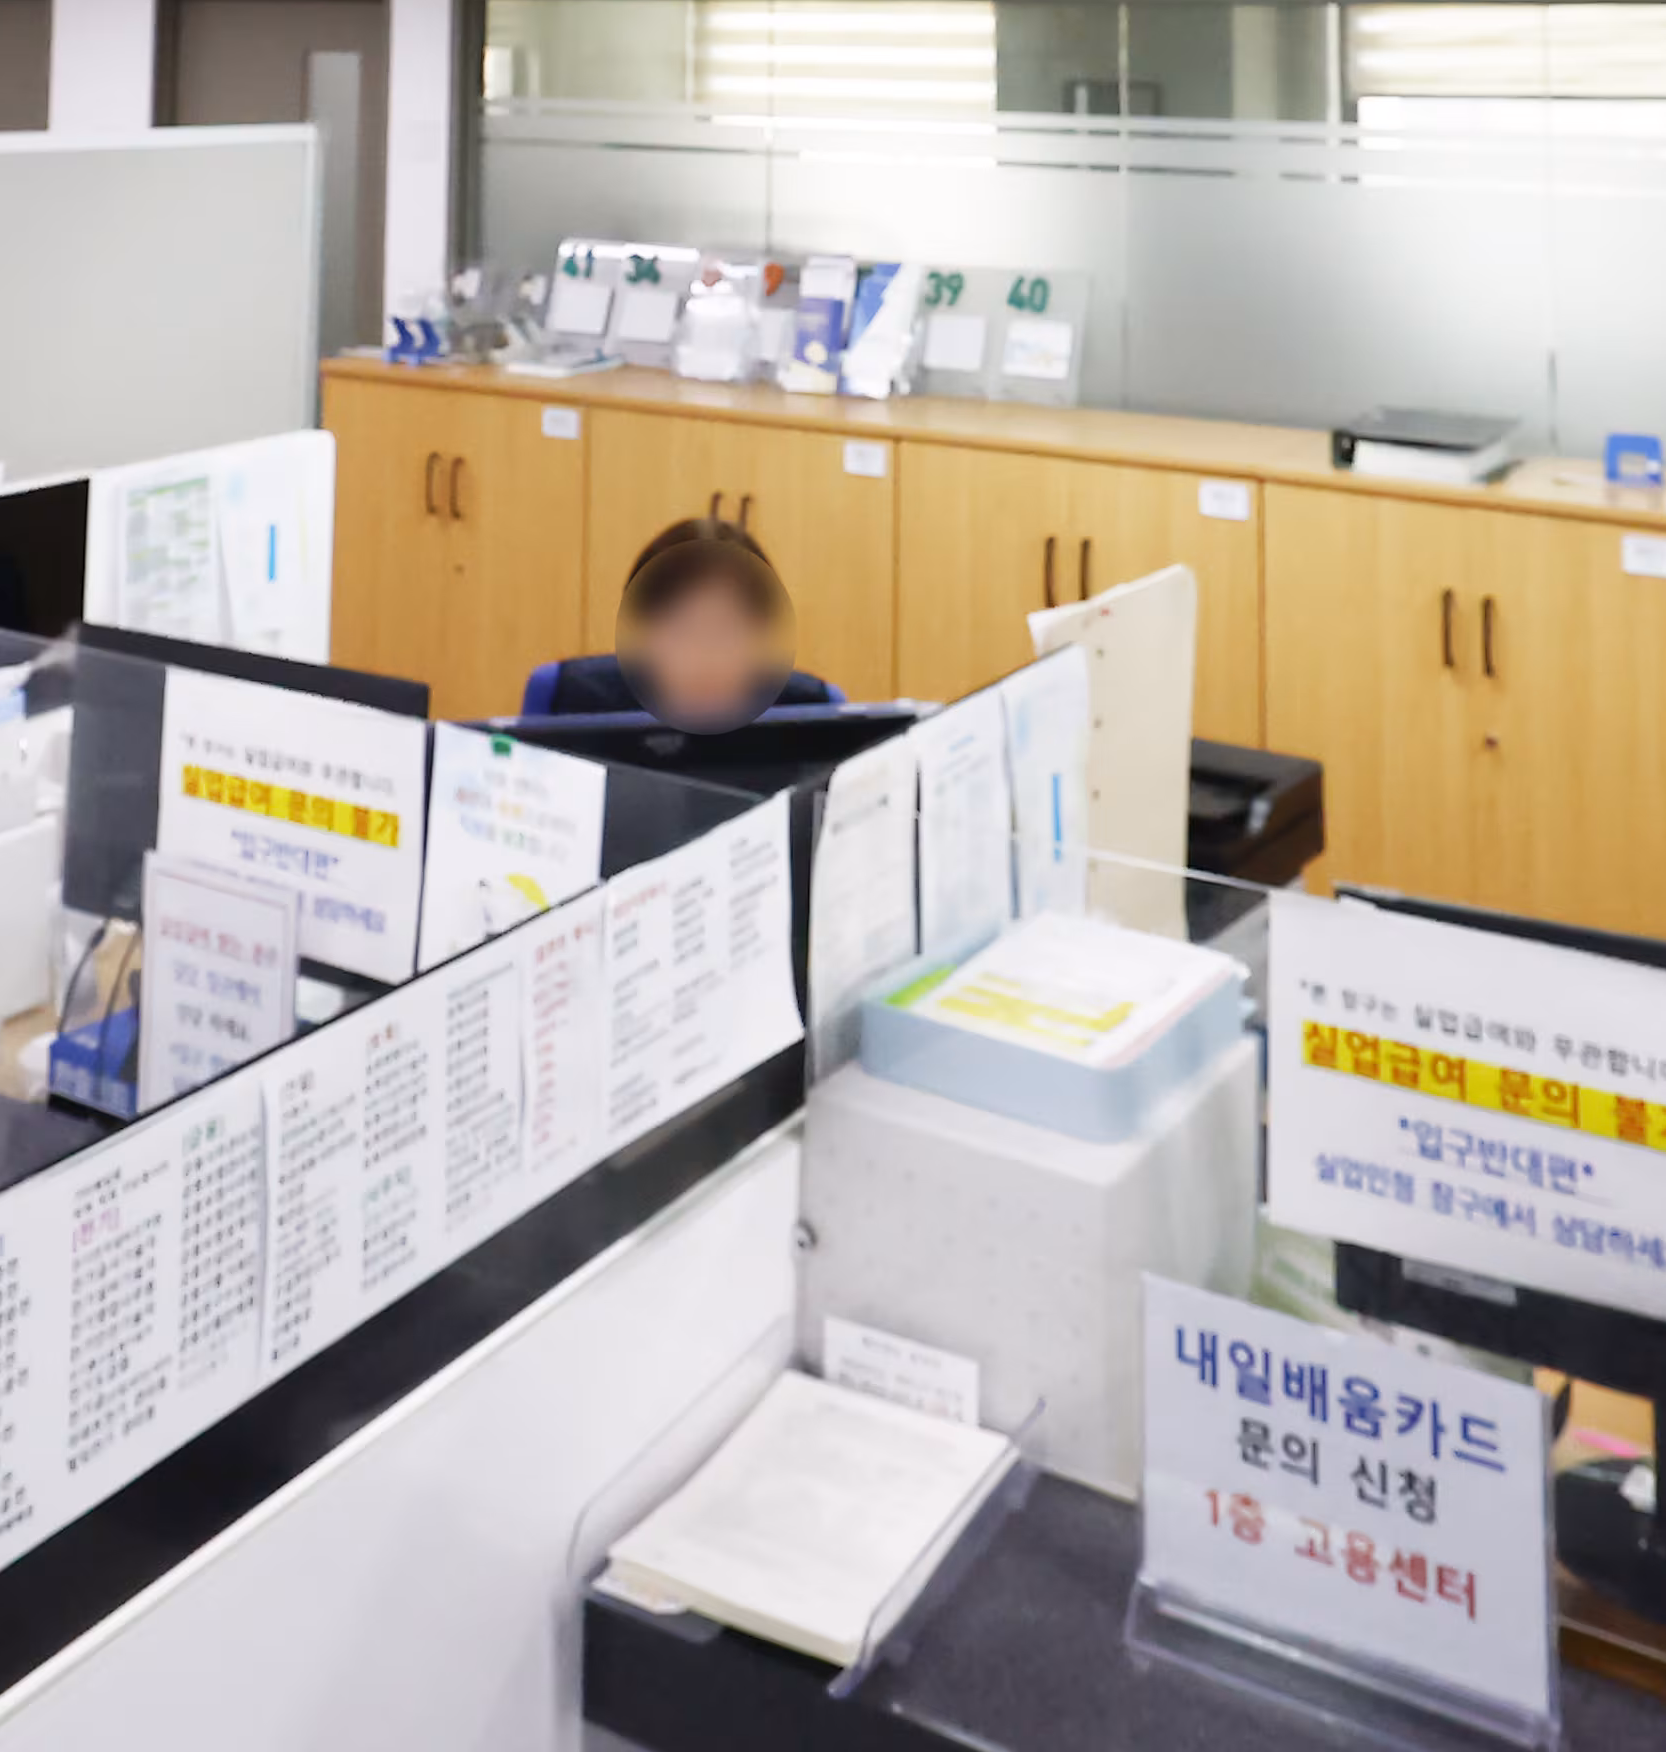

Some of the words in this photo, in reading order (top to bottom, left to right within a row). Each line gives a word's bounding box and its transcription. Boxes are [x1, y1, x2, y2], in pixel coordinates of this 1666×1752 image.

[925, 273, 965, 308] 39
[1007, 276, 1050, 313] 40
[183, 764, 273, 818] 실업급여
[289, 789, 334, 833] 문의
[353, 804, 400, 849] 불가
[1304, 1021, 1469, 1102] 실업급여
[1496, 1065, 1581, 1129] 문의
[1174, 1323, 1508, 1478] 내일배움카드
[1236, 1414, 1322, 1488] 문의
[1349, 1454, 1439, 1530] 신청
[1200, 1486, 1268, 1546] 1층
[1293, 1518, 1479, 1623] 고용센터
